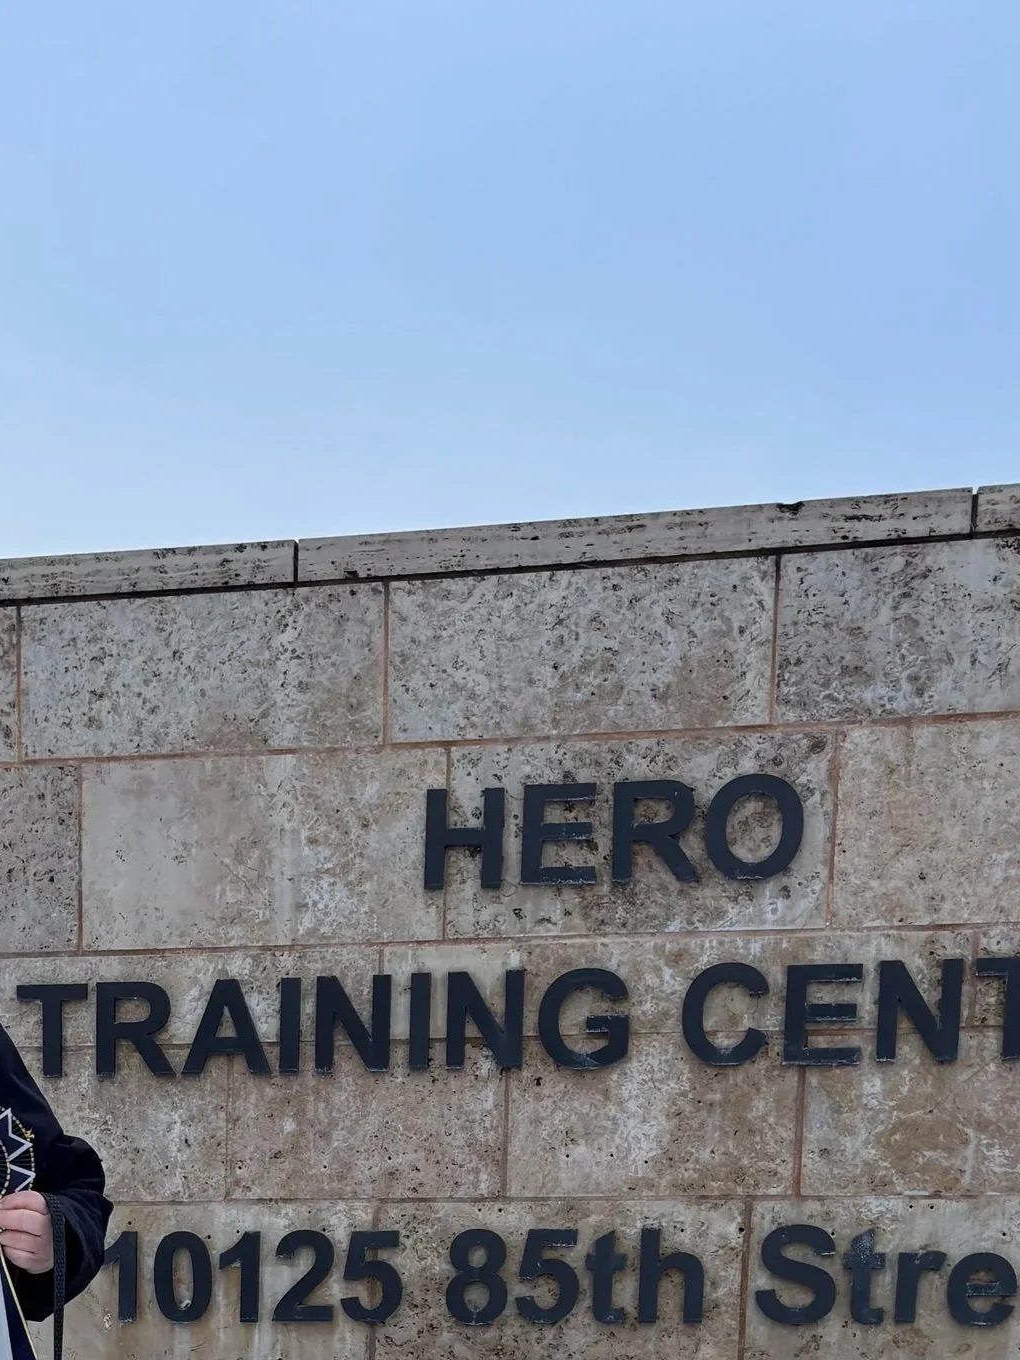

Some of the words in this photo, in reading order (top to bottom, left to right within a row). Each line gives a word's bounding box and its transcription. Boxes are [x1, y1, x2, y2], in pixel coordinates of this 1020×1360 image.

[423, 774, 805, 891] HERO
[17, 967, 631, 1078] TRAINING
[682, 957, 1020, 1067] CENT
[103, 1229, 404, 1325] 10125
[445, 1226, 705, 1325] 85th
[754, 1223, 1018, 1327] Stre
